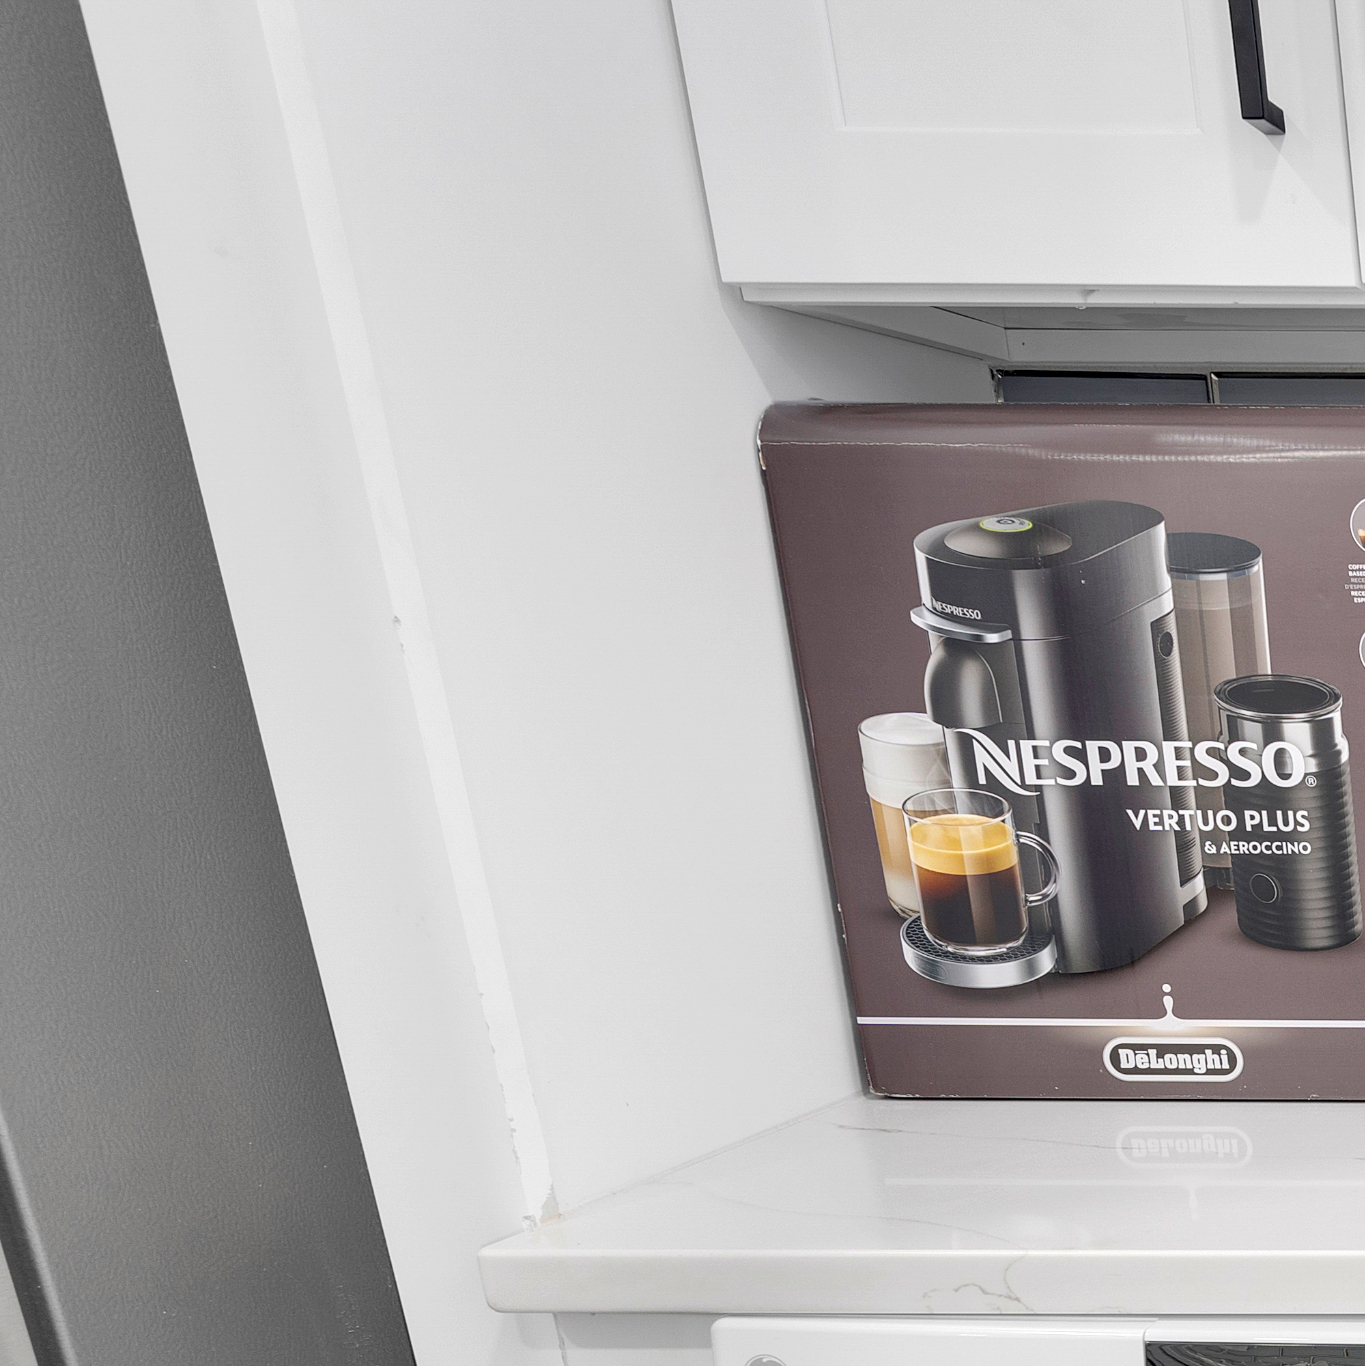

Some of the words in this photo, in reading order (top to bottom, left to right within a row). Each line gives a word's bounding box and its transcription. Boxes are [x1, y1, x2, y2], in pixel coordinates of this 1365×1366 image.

[931, 596, 982, 620] NESPRESSO
[950, 728, 1306, 796] NESPRESSO
[1126, 809, 1238, 832] VERTUO
[1244, 810, 1312, 832] PLUS
[1204, 842, 1217, 855] &
[1220, 841, 1312, 855] AEROCCINO
